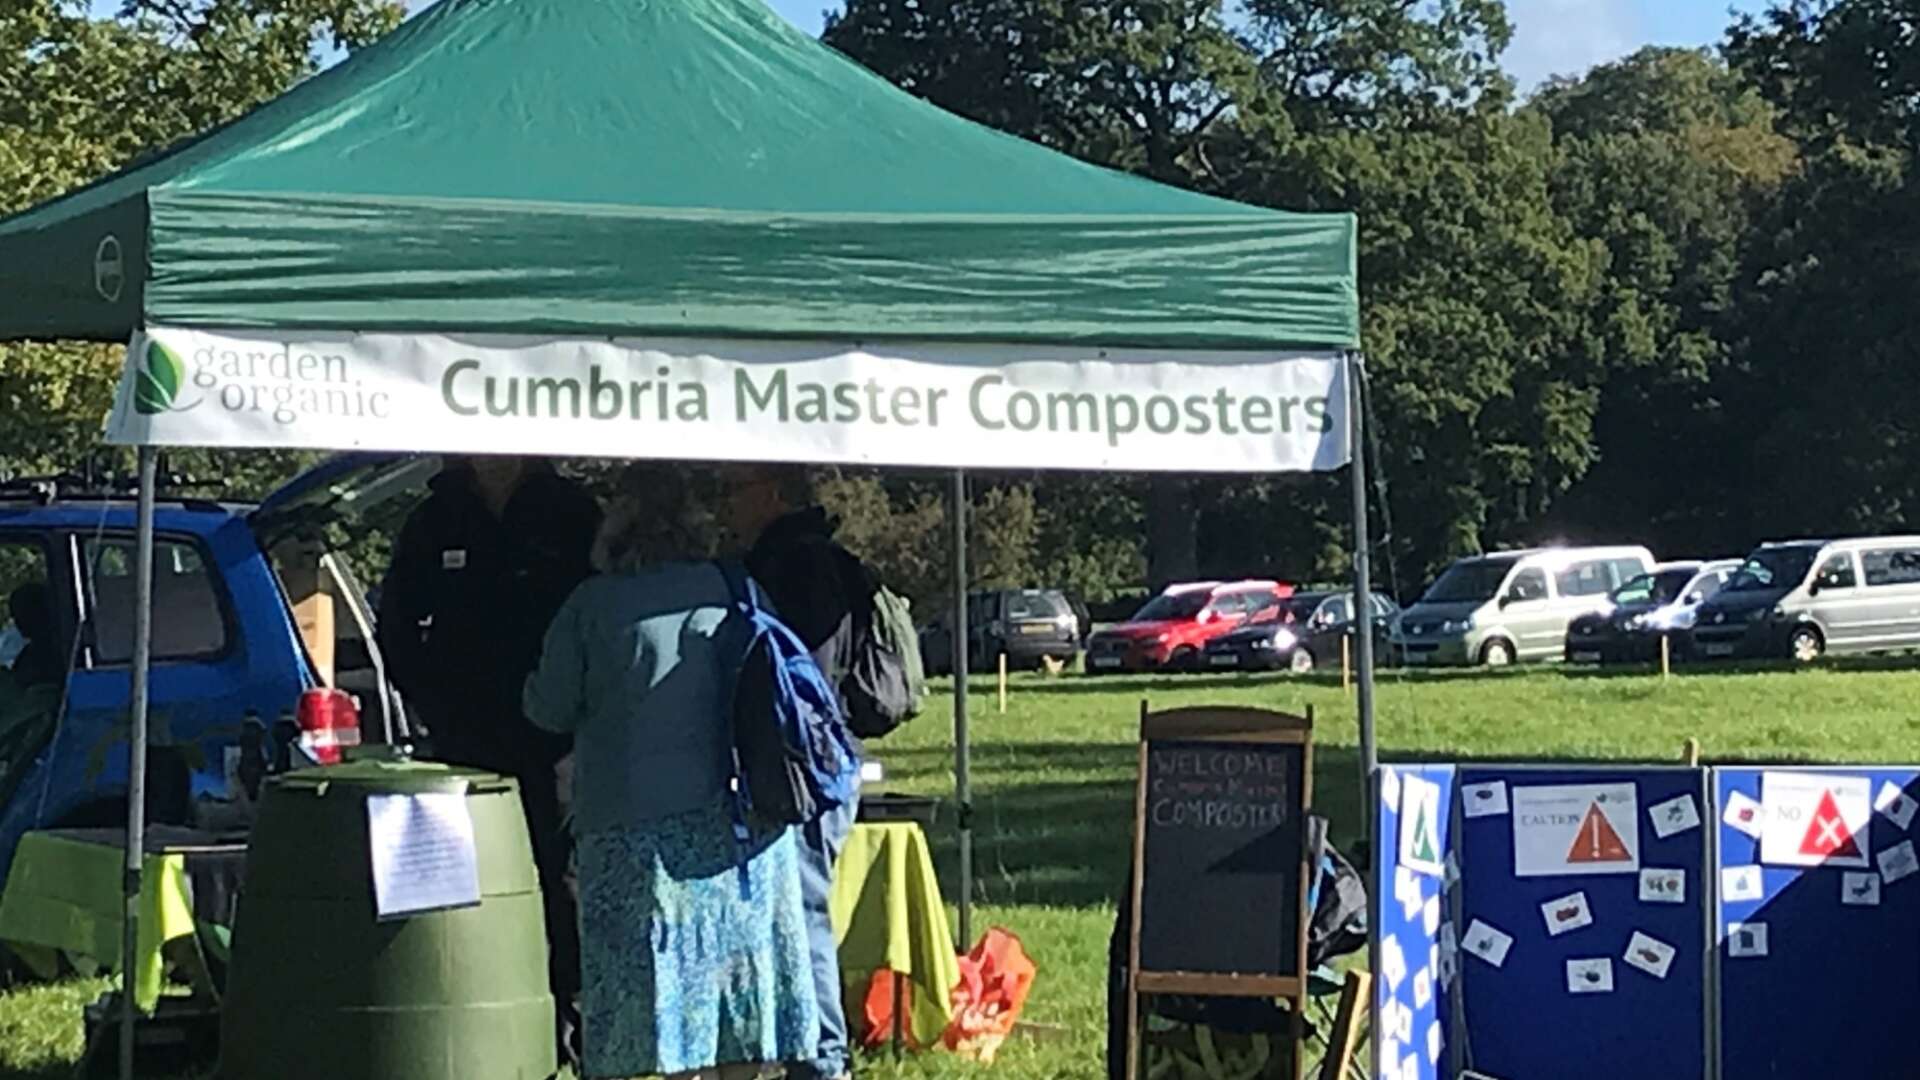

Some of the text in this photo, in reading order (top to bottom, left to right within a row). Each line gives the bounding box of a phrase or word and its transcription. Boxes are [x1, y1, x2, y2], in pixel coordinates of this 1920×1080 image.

[192, 341, 348, 388] garden
[220, 380, 390, 425] organic
[441, 359, 1334, 446] Cumbria Master Composters
[1153, 751, 1283, 776] WELCOME
[1777, 805, 1802, 821] NO
